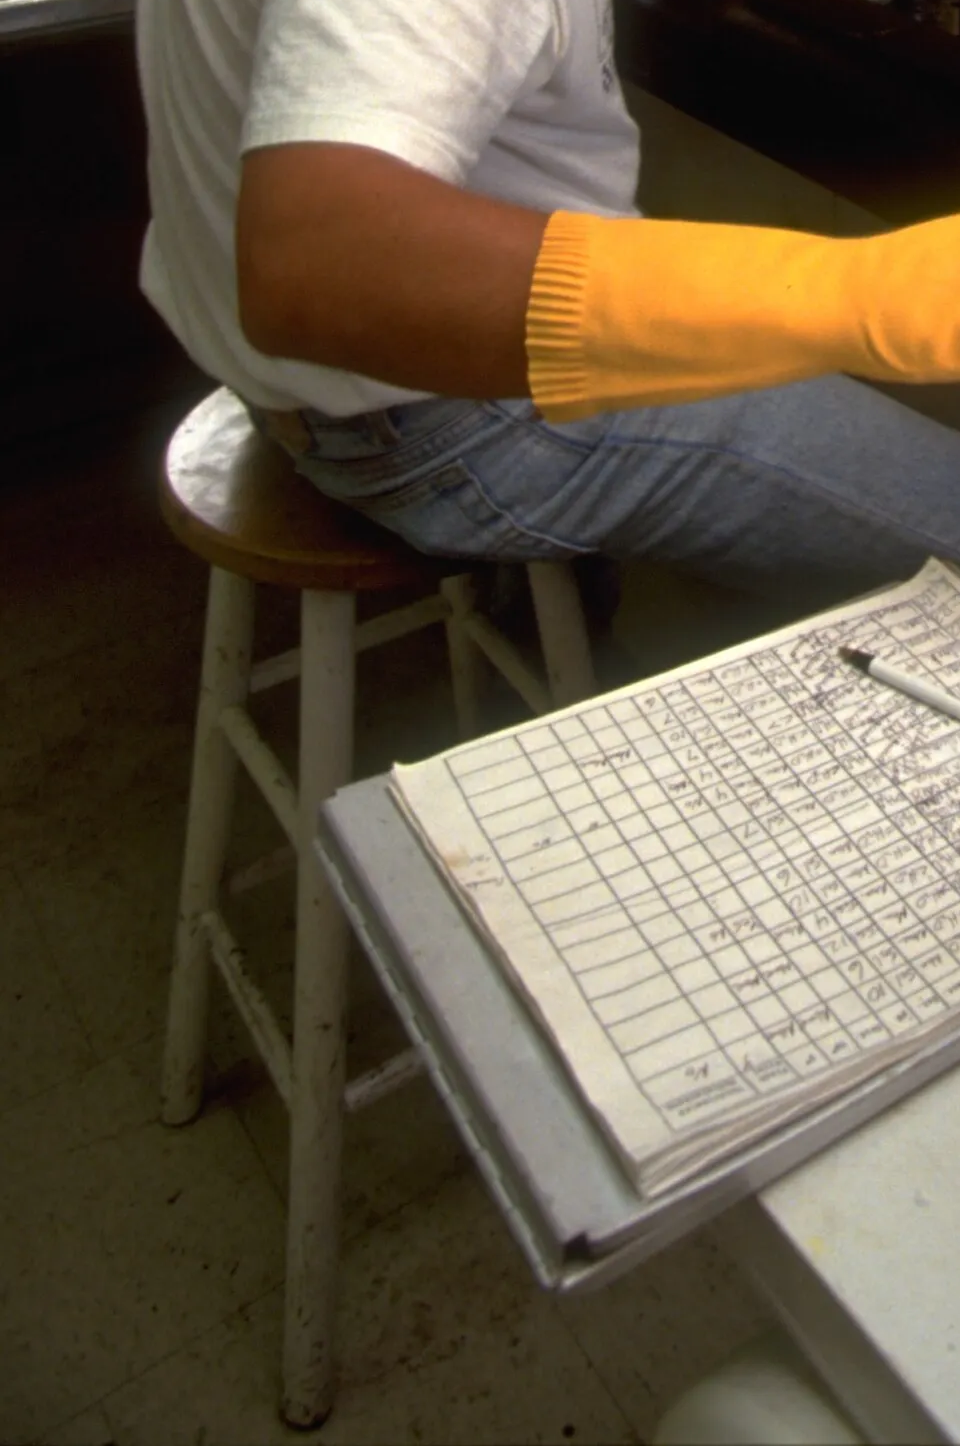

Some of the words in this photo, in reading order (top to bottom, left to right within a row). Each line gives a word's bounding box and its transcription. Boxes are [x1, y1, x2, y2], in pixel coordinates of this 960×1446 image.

[738, 819, 759, 839] 7
[775, 867, 790, 886] 6
[813, 913, 829, 929] 4
[847, 959, 864, 980] 6
[866, 982, 886, 1002] 10
